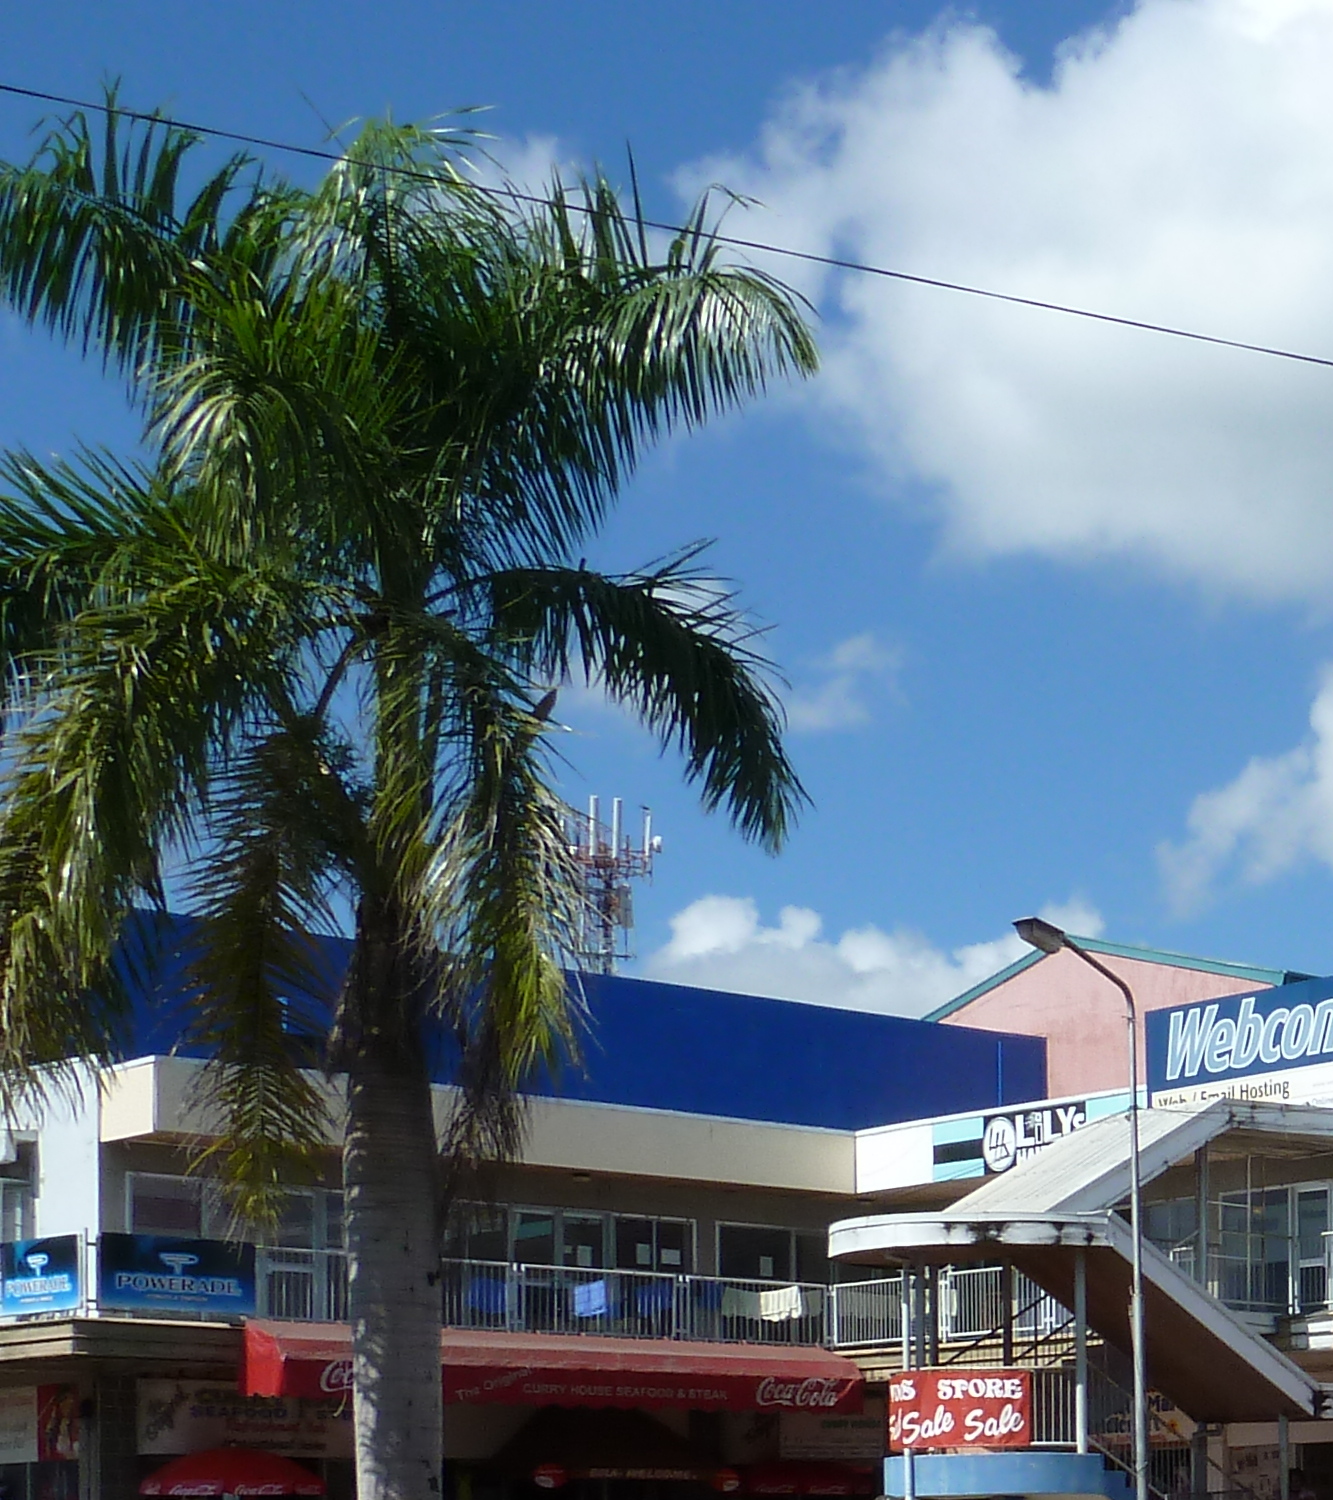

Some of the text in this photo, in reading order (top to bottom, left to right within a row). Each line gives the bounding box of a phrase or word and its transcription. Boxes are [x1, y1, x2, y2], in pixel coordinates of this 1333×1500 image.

[1240, 1080, 1290, 1100] Hosting
[6, 1274, 72, 1297] POWERADE
[116, 1273, 242, 1296] POWERADE
[455, 1387, 479, 1401] The
[483, 1367, 532, 1391] Original
[523, 1384, 566, 1394] CURRY
[570, 1385, 612, 1396] HOUSE
[615, 1386, 673, 1399] SEAFOOD
[688, 1388, 727, 1401] STEAK
[937, 1378, 1023, 1400] STORE
[902, 1404, 954, 1445] Sale
[964, 1403, 1024, 1441] Sale
